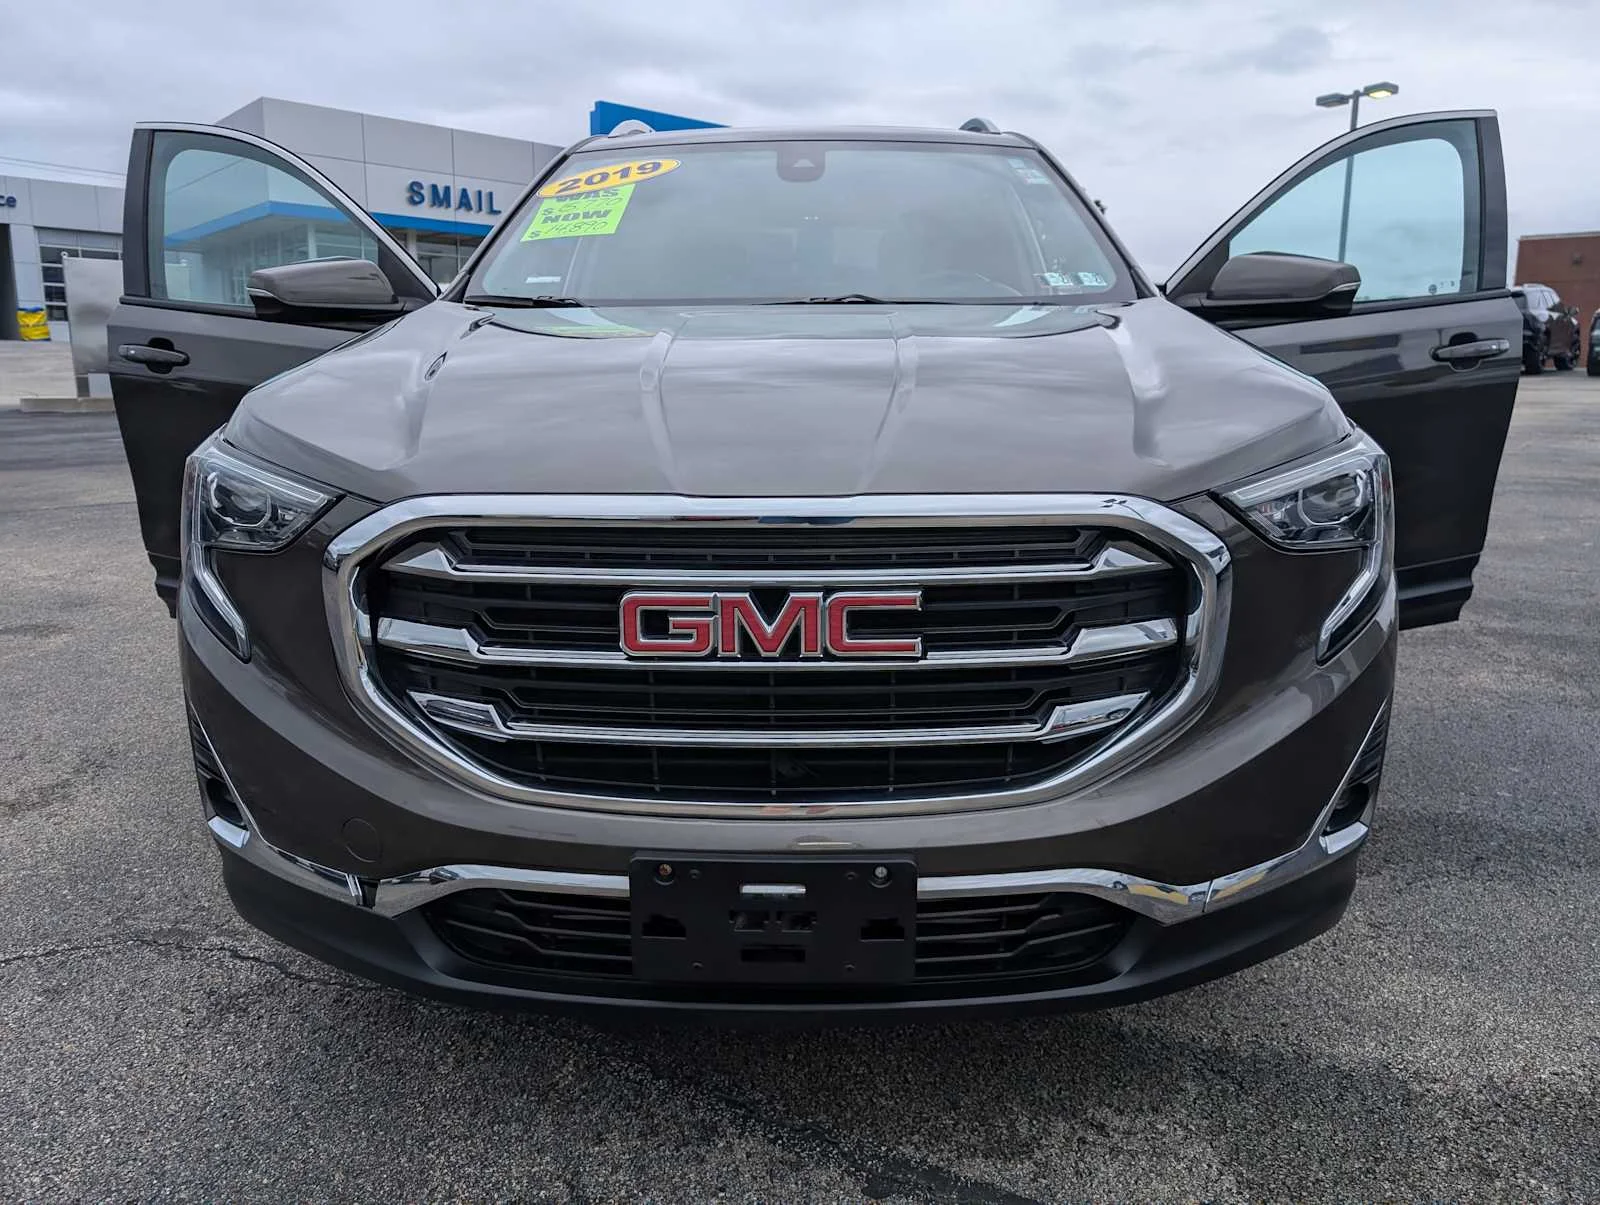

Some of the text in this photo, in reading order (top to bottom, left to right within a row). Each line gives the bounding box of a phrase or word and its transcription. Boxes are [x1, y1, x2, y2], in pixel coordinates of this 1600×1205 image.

[555, 161, 663, 194] 2019
[407, 181, 502, 215] SMAIL
[541, 208, 613, 225] NOW
[619, 590, 923, 658] GMC
